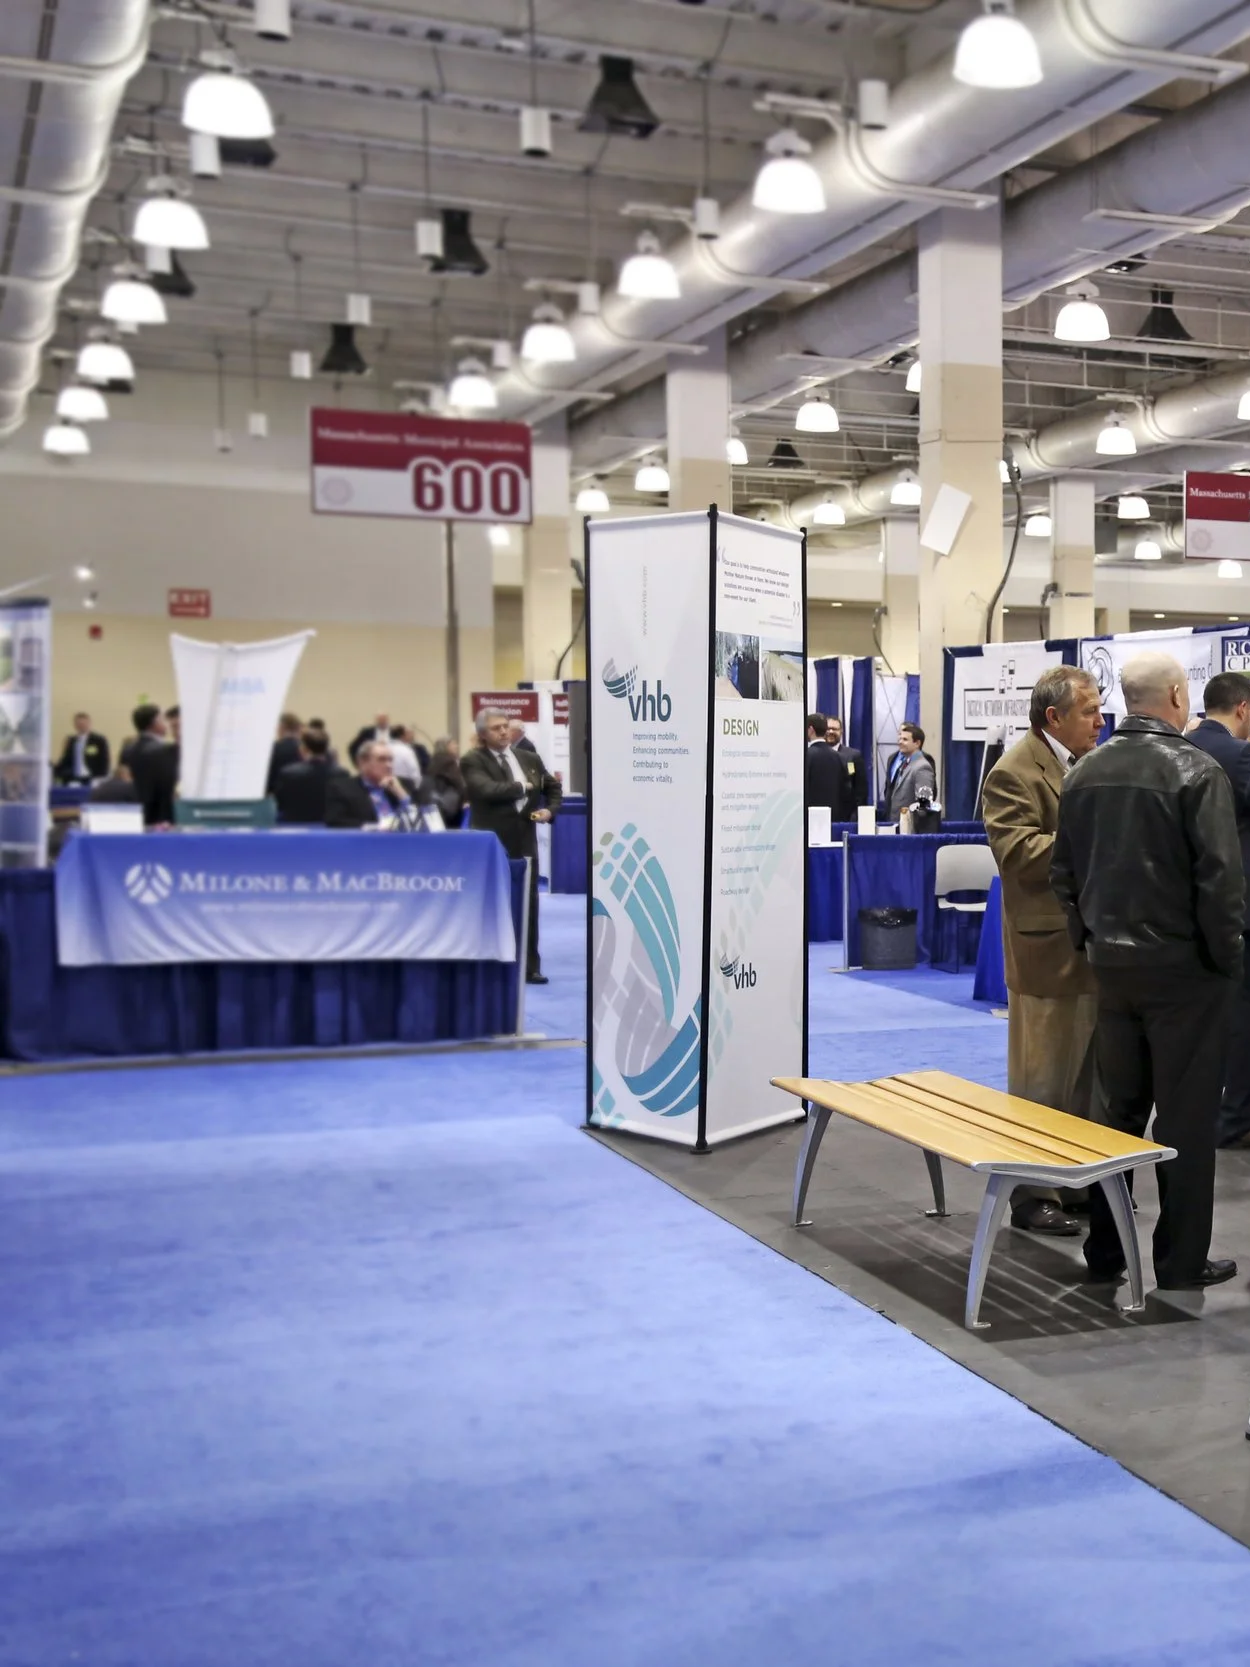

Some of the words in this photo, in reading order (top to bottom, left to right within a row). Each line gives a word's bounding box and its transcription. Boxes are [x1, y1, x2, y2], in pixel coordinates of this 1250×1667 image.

[413, 460, 521, 516] 600
[1190, 487, 1246, 500] Massachusetts
[628, 679, 672, 722] vhb
[723, 718, 759, 736] DESIGN
[632, 732, 657, 742] Improving
[632, 746, 657, 756] Enhancing
[179, 872, 288, 892] MILONE
[293, 872, 312, 892] &
[733, 962, 757, 990] vhb
